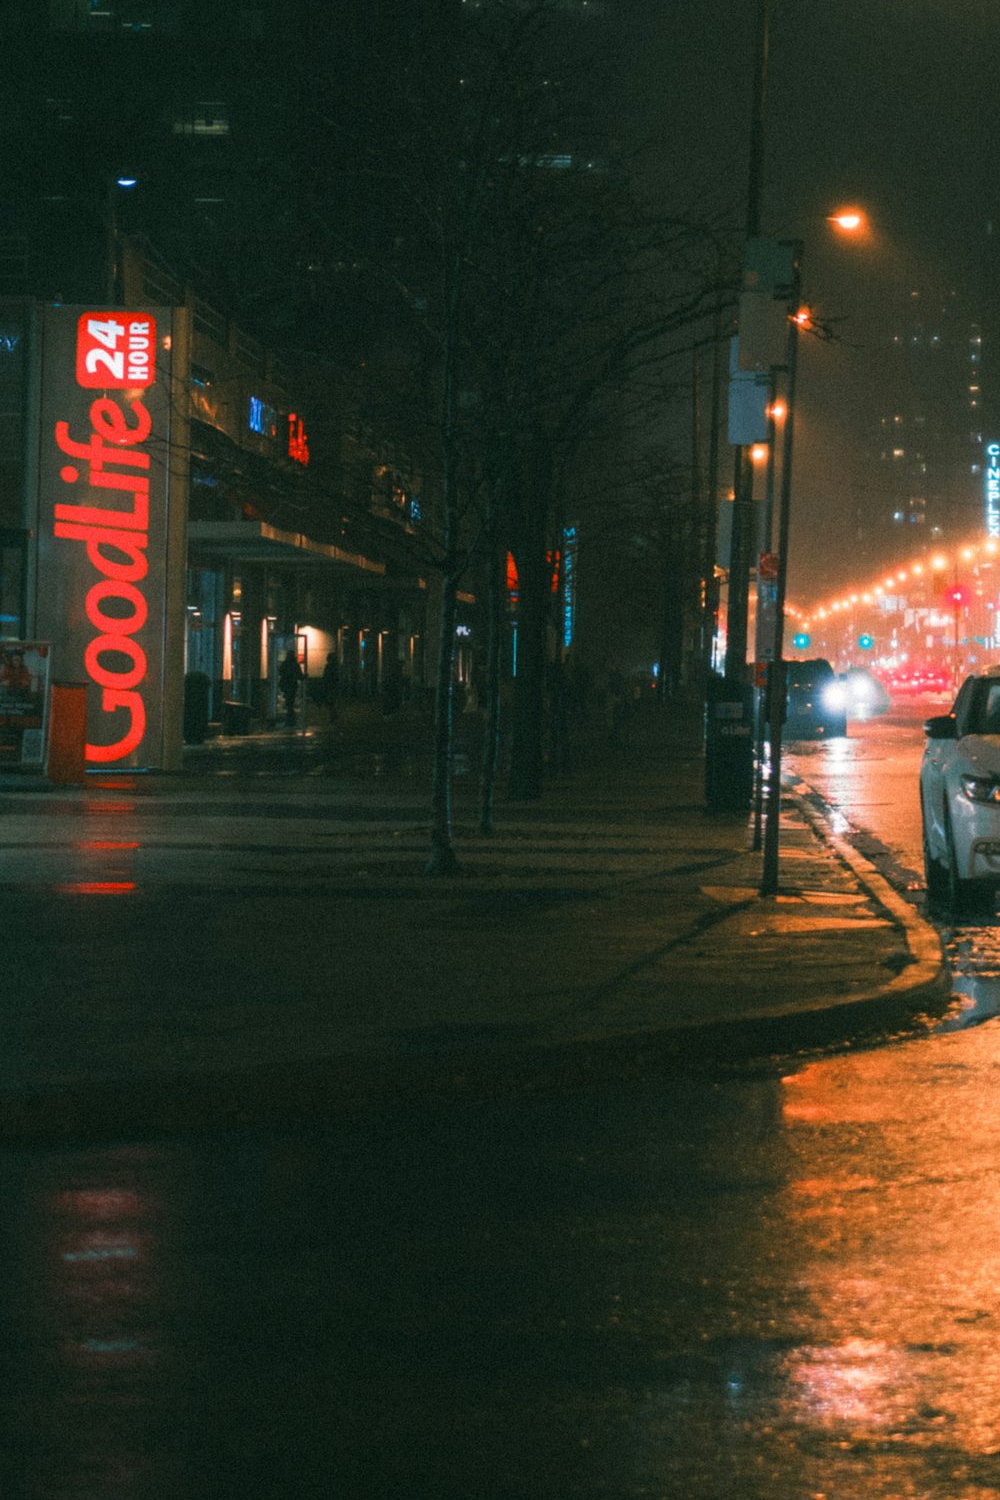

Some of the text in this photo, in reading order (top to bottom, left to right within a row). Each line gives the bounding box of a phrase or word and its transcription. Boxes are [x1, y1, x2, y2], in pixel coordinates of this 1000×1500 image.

[86, 319, 125, 380] 24
[127, 321, 150, 380] HOUR
[987, 444, 1000, 538] CINEPLEX
[54, 397, 153, 762] GoodLife
